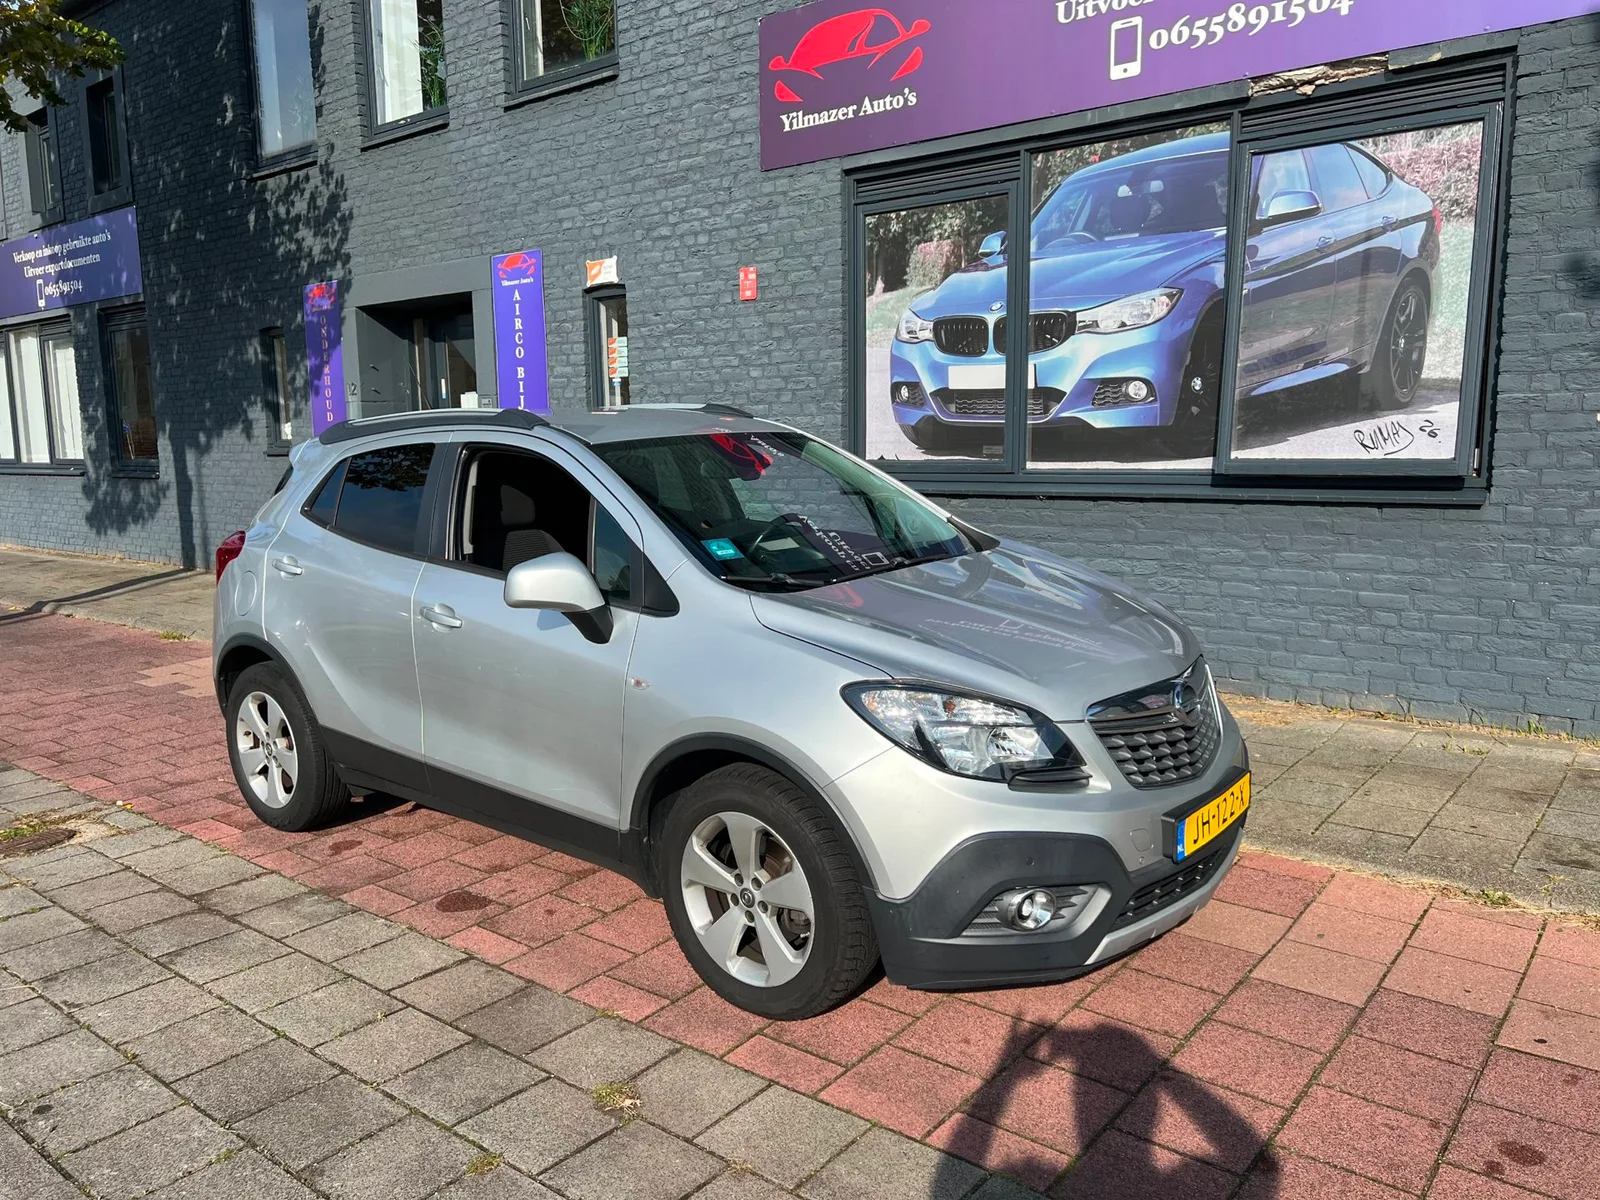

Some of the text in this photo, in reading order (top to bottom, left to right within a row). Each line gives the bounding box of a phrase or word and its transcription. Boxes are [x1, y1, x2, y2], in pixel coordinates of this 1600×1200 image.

[1149, 0, 1354, 49] 0655891504
[780, 87, 917, 132] Yilmazer Auto's
[13, 229, 111, 263] Verkoop en inkoop gebruikte auto's
[24, 253, 101, 278] Uitvoer exportdocumenten
[44, 279, 83, 297] 0655891504
[320, 315, 334, 422] ONDERHOUD
[513, 288, 525, 410] AIRCO BIJ
[1193, 781, 1246, 845] JH-122-X
